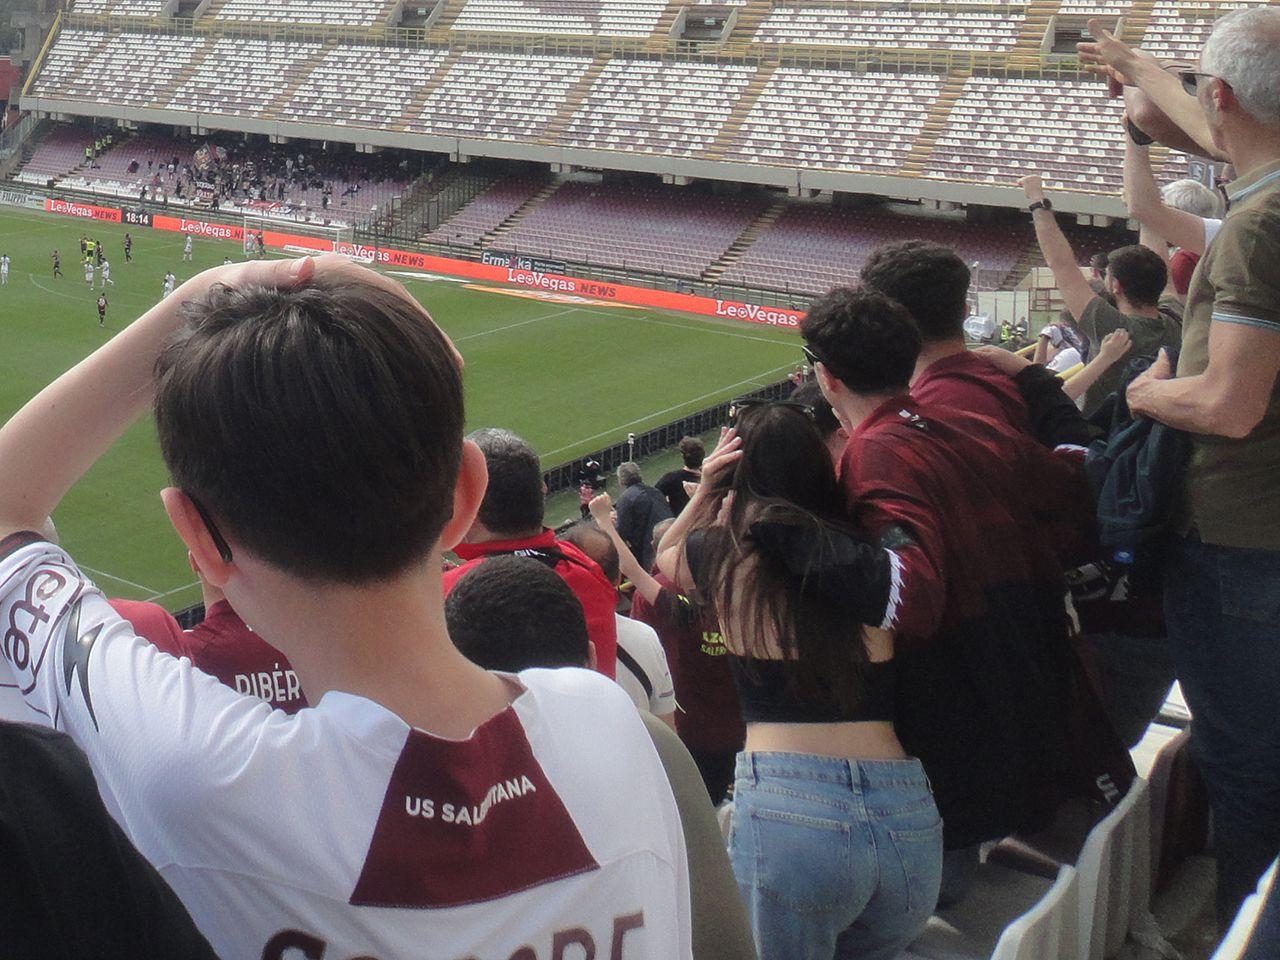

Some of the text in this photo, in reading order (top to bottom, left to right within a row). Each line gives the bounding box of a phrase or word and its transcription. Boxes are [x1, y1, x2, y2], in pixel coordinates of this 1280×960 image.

[125, 212, 149, 225] 18:14
[716, 300, 798, 326] LeoVegas
[405, 795, 435, 818] US
